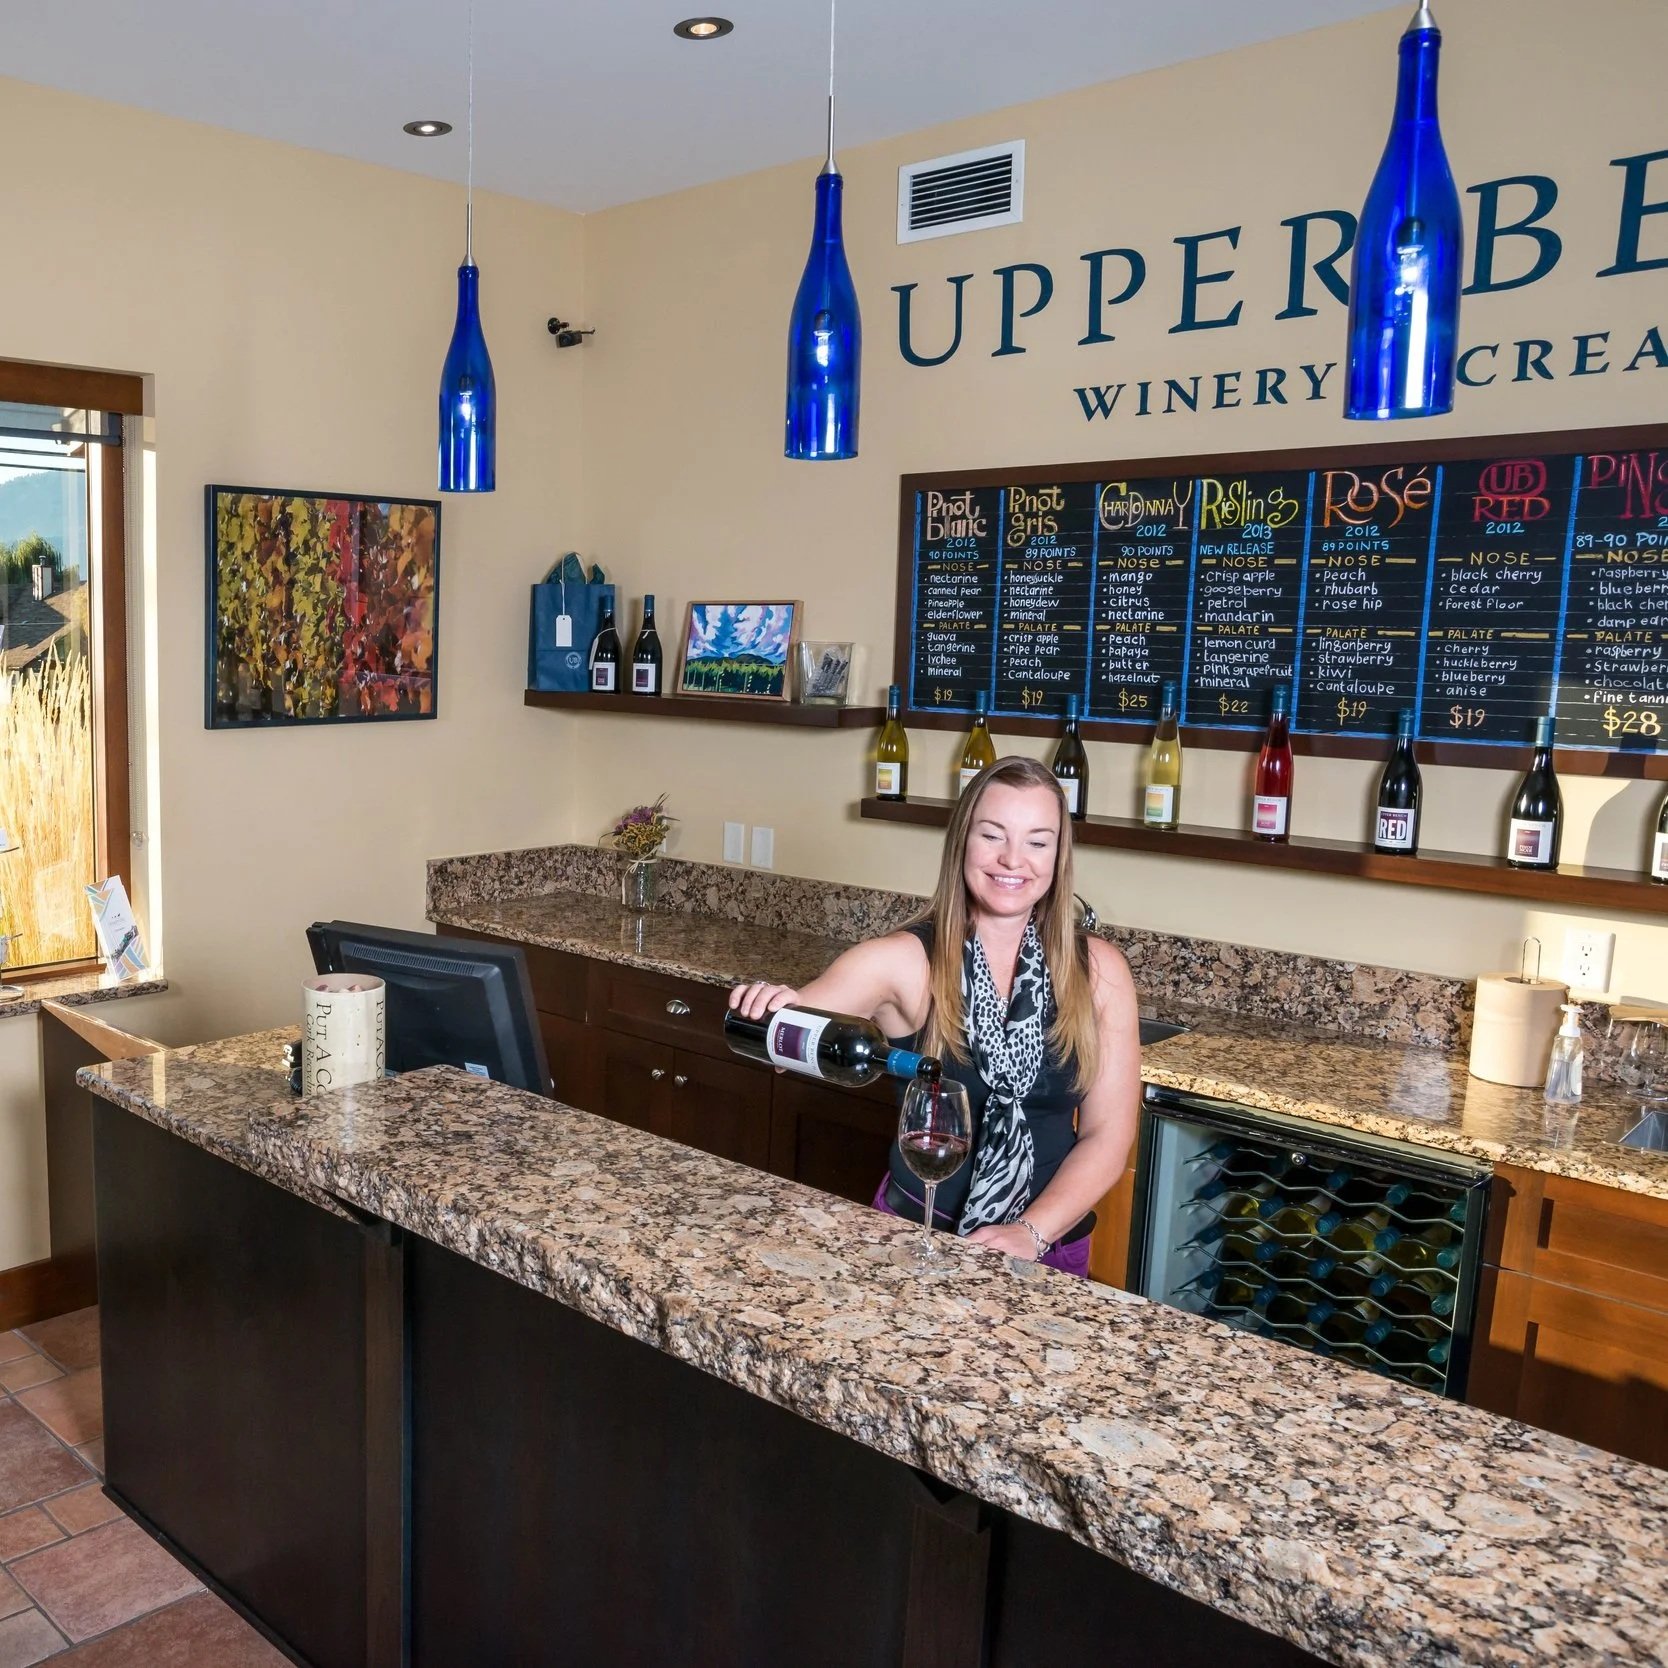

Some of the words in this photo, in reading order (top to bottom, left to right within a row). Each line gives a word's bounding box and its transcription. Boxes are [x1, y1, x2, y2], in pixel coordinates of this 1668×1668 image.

[891, 209, 1359, 368] UPPER
[1461, 149, 1668, 298] BE
[1073, 362, 1338, 423] WINERY
[1456, 327, 1668, 387] CREA
[926, 490, 980, 519] Pinot
[1007, 486, 1065, 513] Pinot
[1472, 496, 1551, 522] RED
[926, 516, 987, 541] blanc
[1007, 511, 1058, 547] gris
[1136, 524, 1167, 538] 2012
[1242, 524, 1272, 540] 2013
[1345, 526, 1380, 537] 2012
[1486, 522, 1525, 534] 2012
[946, 538, 976, 548] 2012
[1030, 536, 1058, 546] 2012
[1322, 542, 1336, 552] 89
[1338, 540, 1390, 551] POINTS
[1576, 534, 1627, 548] 89-90
[928, 552, 940, 560] 90
[942, 551, 979, 560] POINTS
[1025, 548, 1038, 558] 89
[1040, 547, 1076, 558] POINTS
[1121, 546, 1135, 556] 90
[1137, 546, 1174, 556] POINTS
[1200, 544, 1224, 556] NEW
[1226, 542, 1275, 555] RELEASE
[1222, 556, 1268, 568] NOSE
[1328, 555, 1381, 567] NOSE
[1470, 552, 1530, 566] NOSE
[1607, 549, 1668, 564] NOSE
[942, 562, 974, 571] NOSE
[1024, 560, 1062, 570] NOSE
[930, 572, 978, 584] nectarine
[1109, 571, 1153, 584] mango
[1242, 570, 1276, 583] apple
[1324, 568, 1366, 582] peach
[1451, 568, 1488, 582] black
[1495, 568, 1542, 585] cherry
[1598, 566, 1668, 580] raspberry
[928, 586, 957, 596] canned
[1010, 585, 1054, 596] nectarine
[1108, 584, 1142, 595] honey
[1324, 582, 1378, 596] rhubarb
[1450, 583, 1501, 594] cedar
[1600, 582, 1668, 595] blueberr
[1010, 596, 1060, 609] honeydew
[1110, 596, 1150, 607] citrus
[1208, 596, 1247, 610] petrol
[1322, 599, 1358, 610] rose
[1362, 598, 1383, 611] hip
[1445, 598, 1482, 610] forest
[1486, 598, 1524, 610] floor
[1598, 598, 1633, 611] black
[927, 609, 982, 620] elderflower
[1010, 610, 1046, 621] mineral
[1108, 608, 1164, 620] nectarine
[1204, 610, 1274, 622] mandarin
[938, 622, 970, 630] PALATE
[1018, 623, 1058, 632] PALATE
[1115, 623, 1151, 632] PALATE
[1598, 616, 1636, 628] damp
[1218, 624, 1260, 635] PALATE
[1326, 628, 1368, 638] PALATE
[1448, 629, 1494, 640] PALATE
[926, 632, 956, 642] guava
[1008, 633, 1033, 642] crisp
[1036, 634, 1059, 644] apple
[1204, 636, 1242, 649] lemon
[1244, 638, 1276, 650] curd
[1594, 631, 1653, 643] PALATE
[928, 642, 976, 654] tangerine
[1009, 644, 1030, 655] ripe
[1319, 637, 1392, 654] lingonberry
[1444, 643, 1490, 656] cherry
[1595, 644, 1662, 660] raspberry
[928, 654, 957, 665] lychee
[1204, 650, 1269, 664] tangerine
[1318, 652, 1394, 666] strawberry
[1109, 659, 1150, 670] butter
[1203, 663, 1230, 675] pink
[1232, 664, 1292, 677] grapefruit
[1443, 658, 1518, 670] huckleberry
[928, 667, 962, 676] mineral
[1108, 672, 1161, 684] hazelnut
[1318, 666, 1352, 678] kiwi
[1442, 671, 1506, 685] blueberry
[1200, 674, 1250, 688] mineral
[1316, 678, 1396, 696] cantaloupe
[934, 686, 953, 704] $19
[1446, 685, 1487, 696] anise
[1594, 690, 1624, 704] fine
[1022, 686, 1044, 709] $19
[1118, 688, 1148, 712] $25
[1219, 692, 1248, 716] $22
[1337, 696, 1367, 726] $19
[1450, 704, 1485, 728] $19
[1602, 704, 1662, 738] $28
[1380, 818, 1407, 840] RED
[316, 1004, 332, 1040] PUT
[376, 1000, 385, 1033] PUT
[306, 1014, 316, 1042] Cork
[376, 1036, 385, 1052] A
[778, 1026, 786, 1054] MERLOT
[316, 1045, 332, 1062] A
